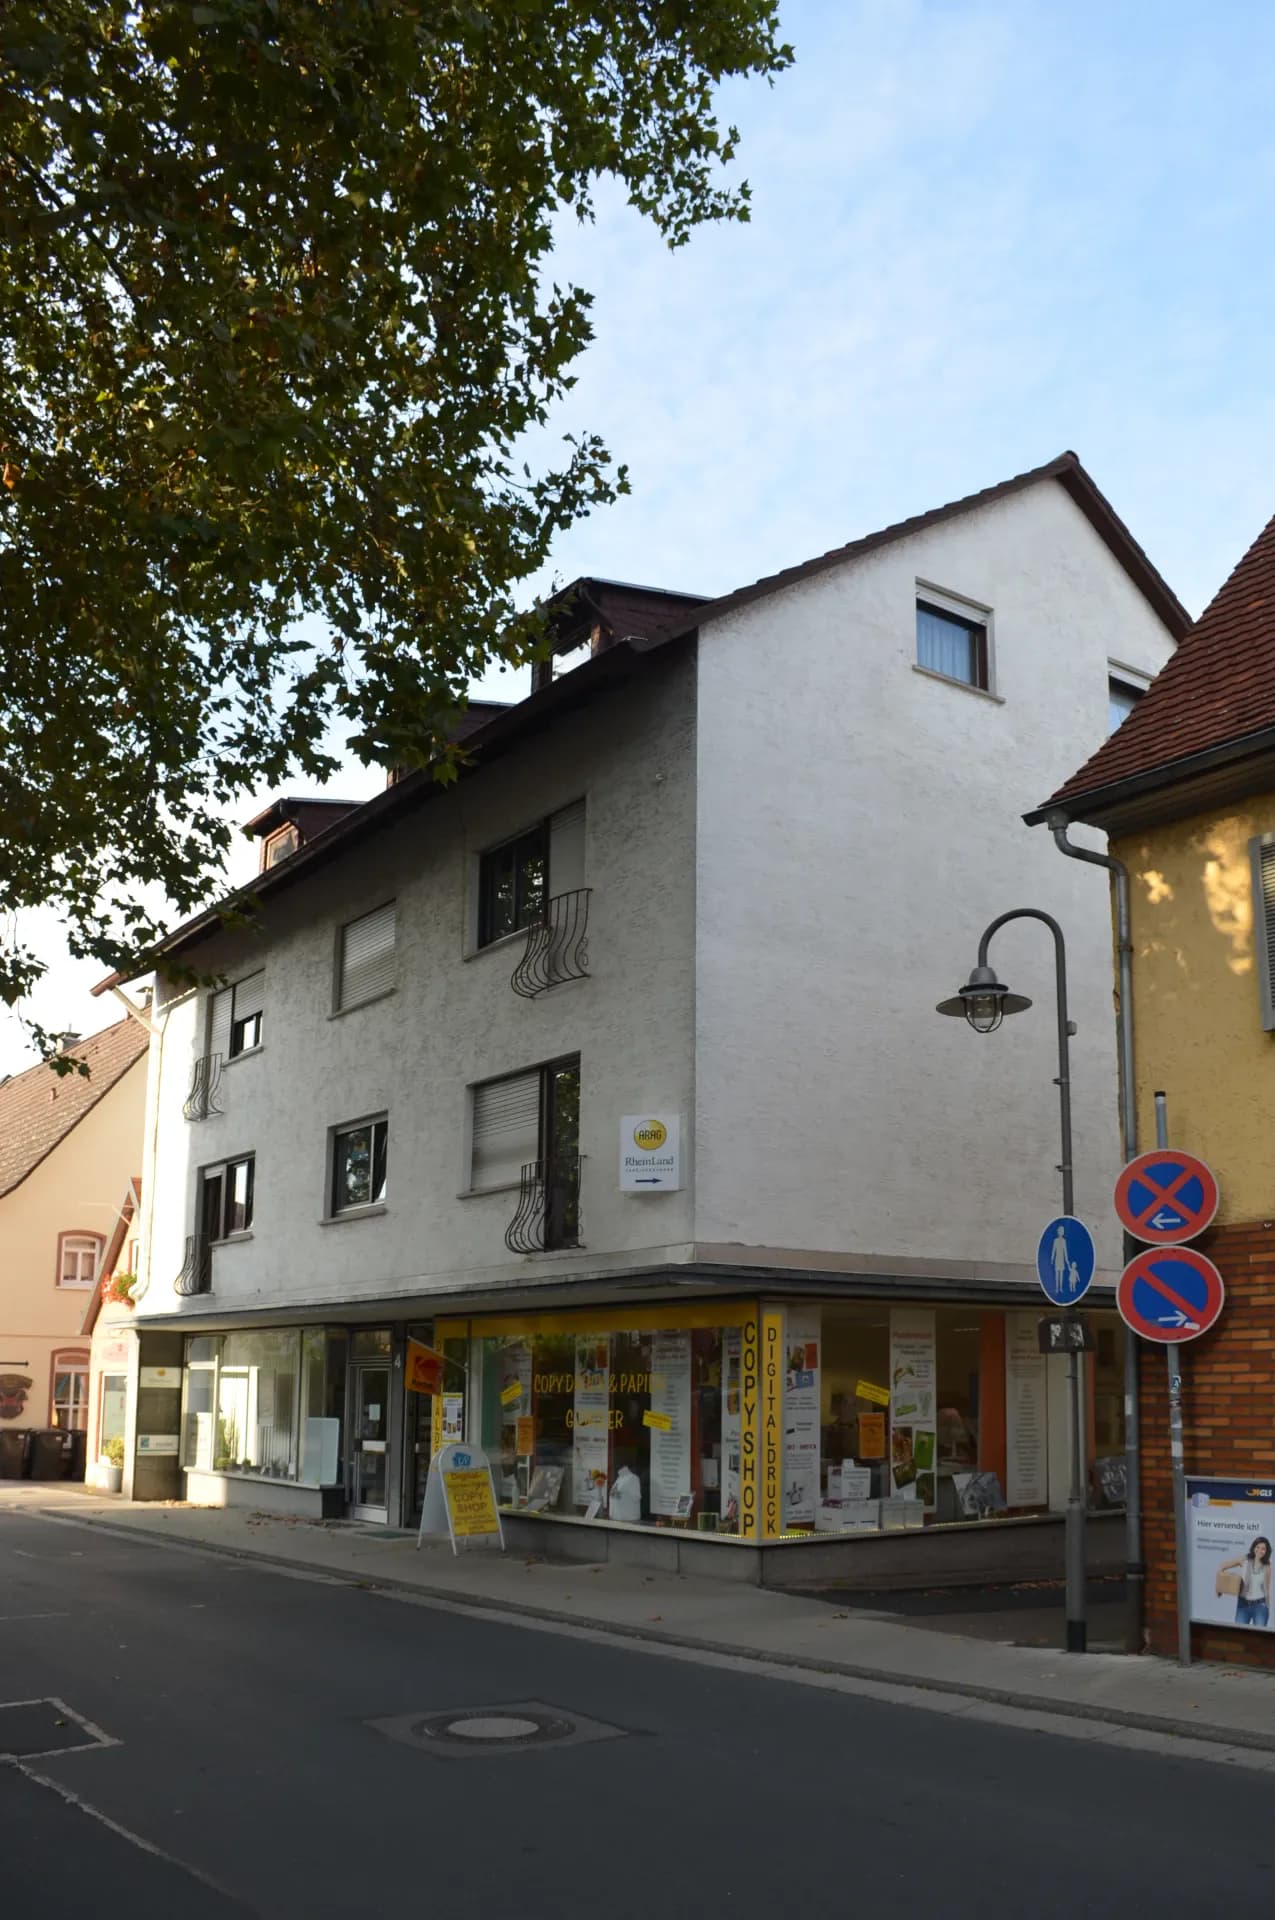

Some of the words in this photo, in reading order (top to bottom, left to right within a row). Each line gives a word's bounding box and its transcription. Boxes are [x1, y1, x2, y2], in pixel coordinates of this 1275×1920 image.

[639, 1130, 662, 1140] ARAG
[625, 1156, 674, 1166] RheinLand
[534, 1374, 563, 1393] COPY
[743, 1321, 756, 1537] COPYSHOP
[767, 1327, 777, 1534] DIGITALDRUCK
[1260, 1489, 1273, 1497] GLS
[1197, 1520, 1212, 1528] Hier
